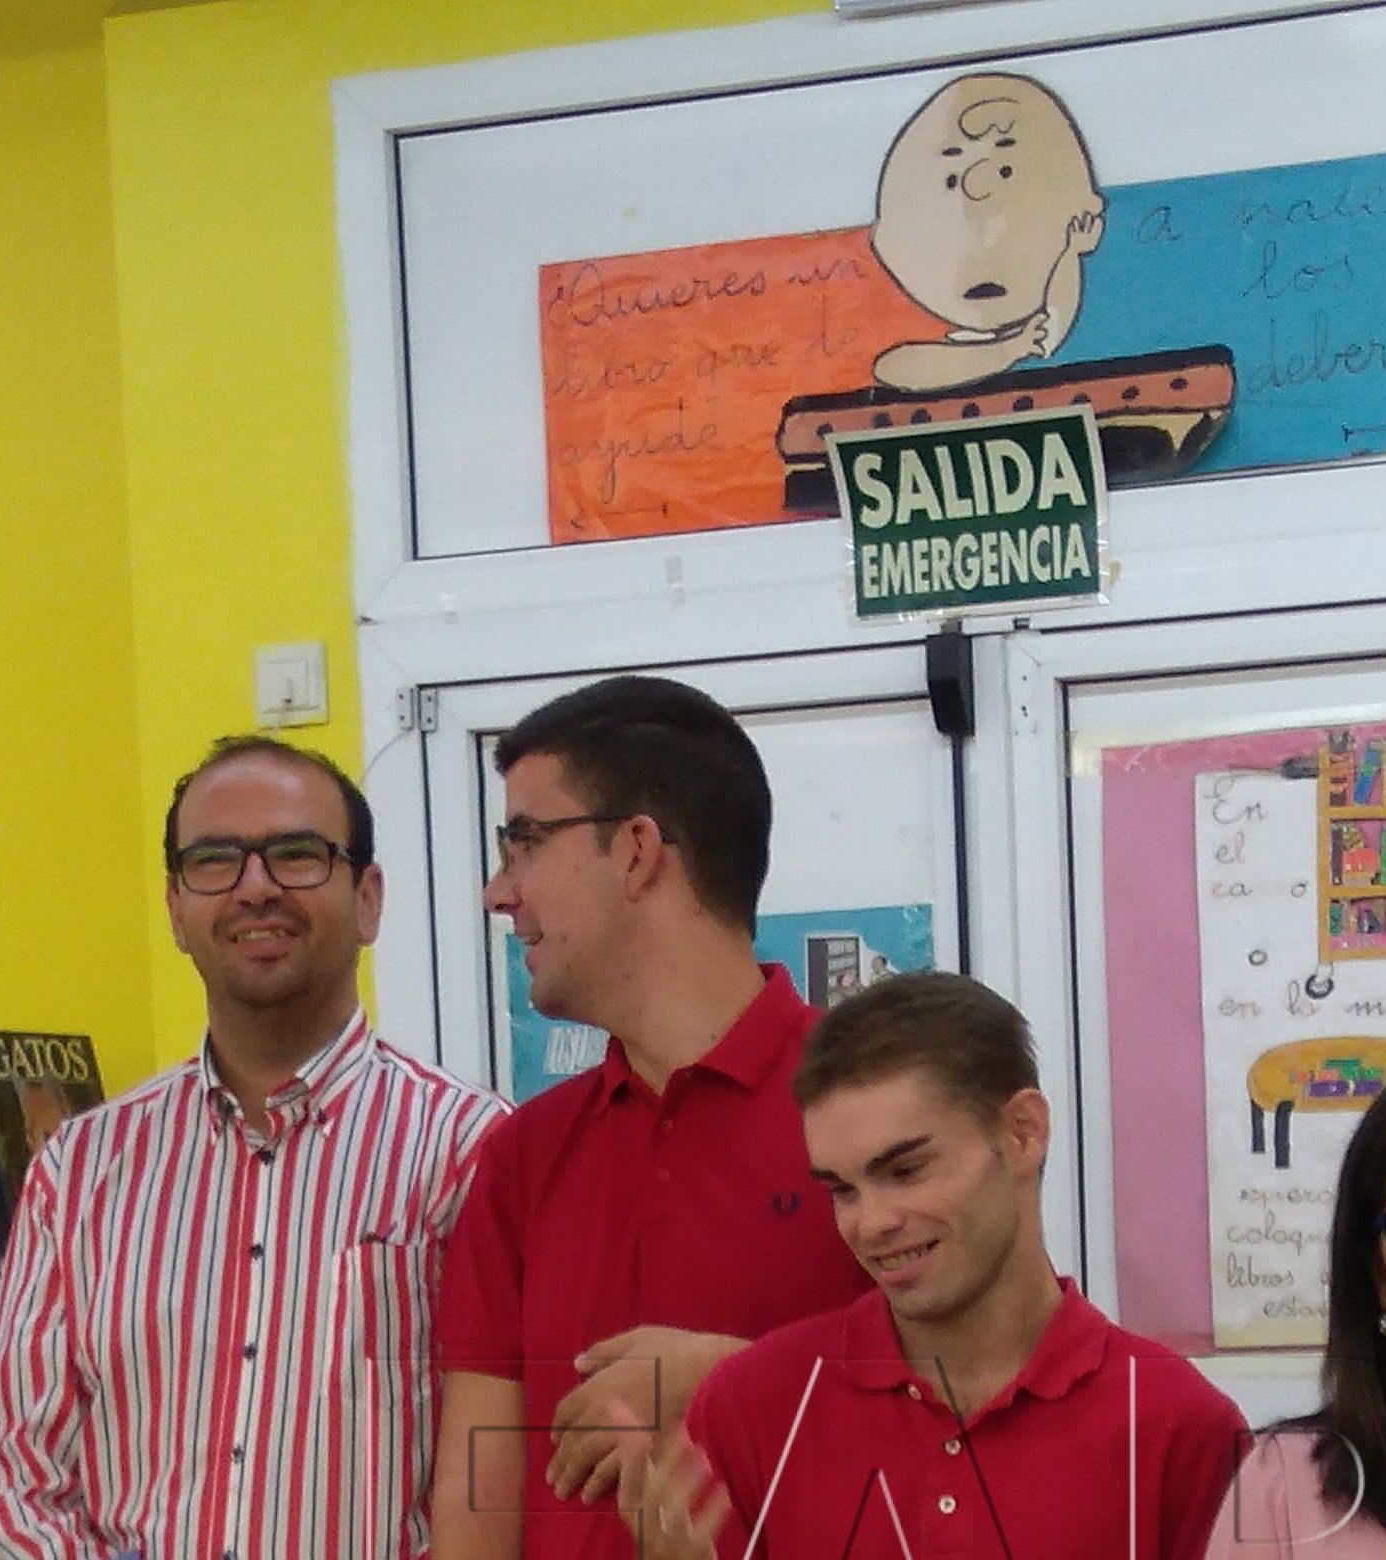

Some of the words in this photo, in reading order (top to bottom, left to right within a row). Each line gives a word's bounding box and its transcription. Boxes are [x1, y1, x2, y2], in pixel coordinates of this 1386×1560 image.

[1137, 204, 1185, 244] a
[1242, 239, 1356, 300] los
[852, 432, 1088, 529] SALIDA
[862, 523, 1092, 598] EMERGENCIA
